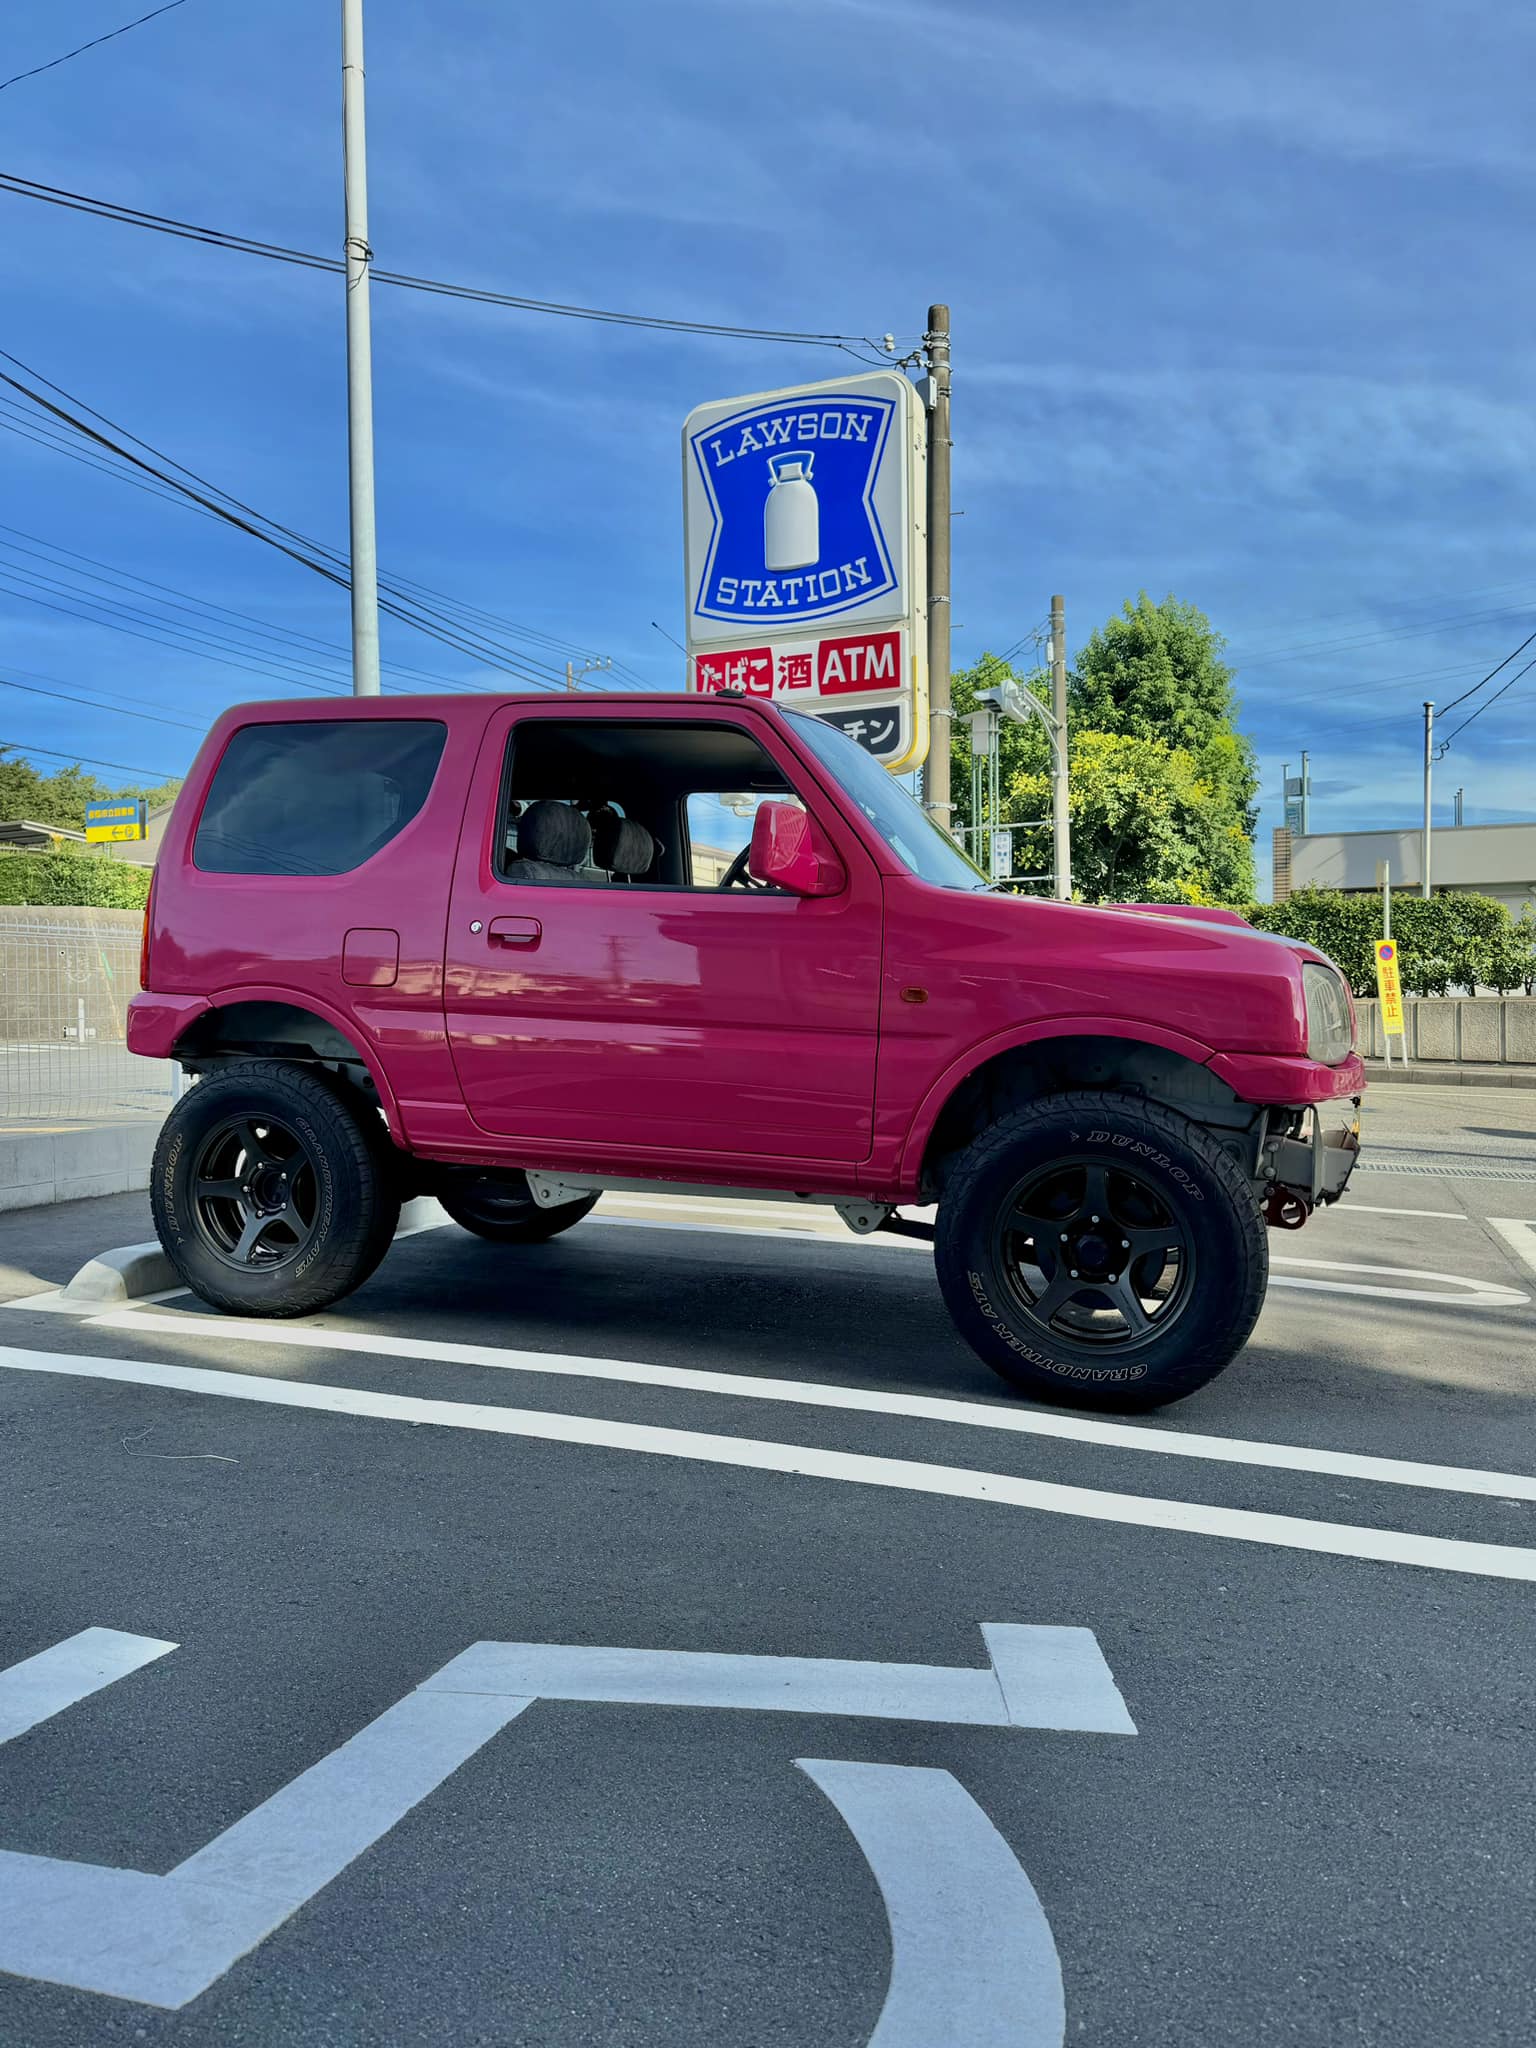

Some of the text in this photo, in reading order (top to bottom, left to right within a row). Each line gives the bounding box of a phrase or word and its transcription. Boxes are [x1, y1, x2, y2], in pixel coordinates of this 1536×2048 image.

[710, 411, 874, 467] LAWSON
[715, 556, 873, 609] STATION
[700, 653, 813, 693] たばこ 酒
[821, 642, 895, 685] ATM
[1381, 966, 1399, 1018] 駐車禁止
[1086, 1130, 1205, 1201] DUNLOP
[991, 1322, 1148, 1381] GRANDTREK
